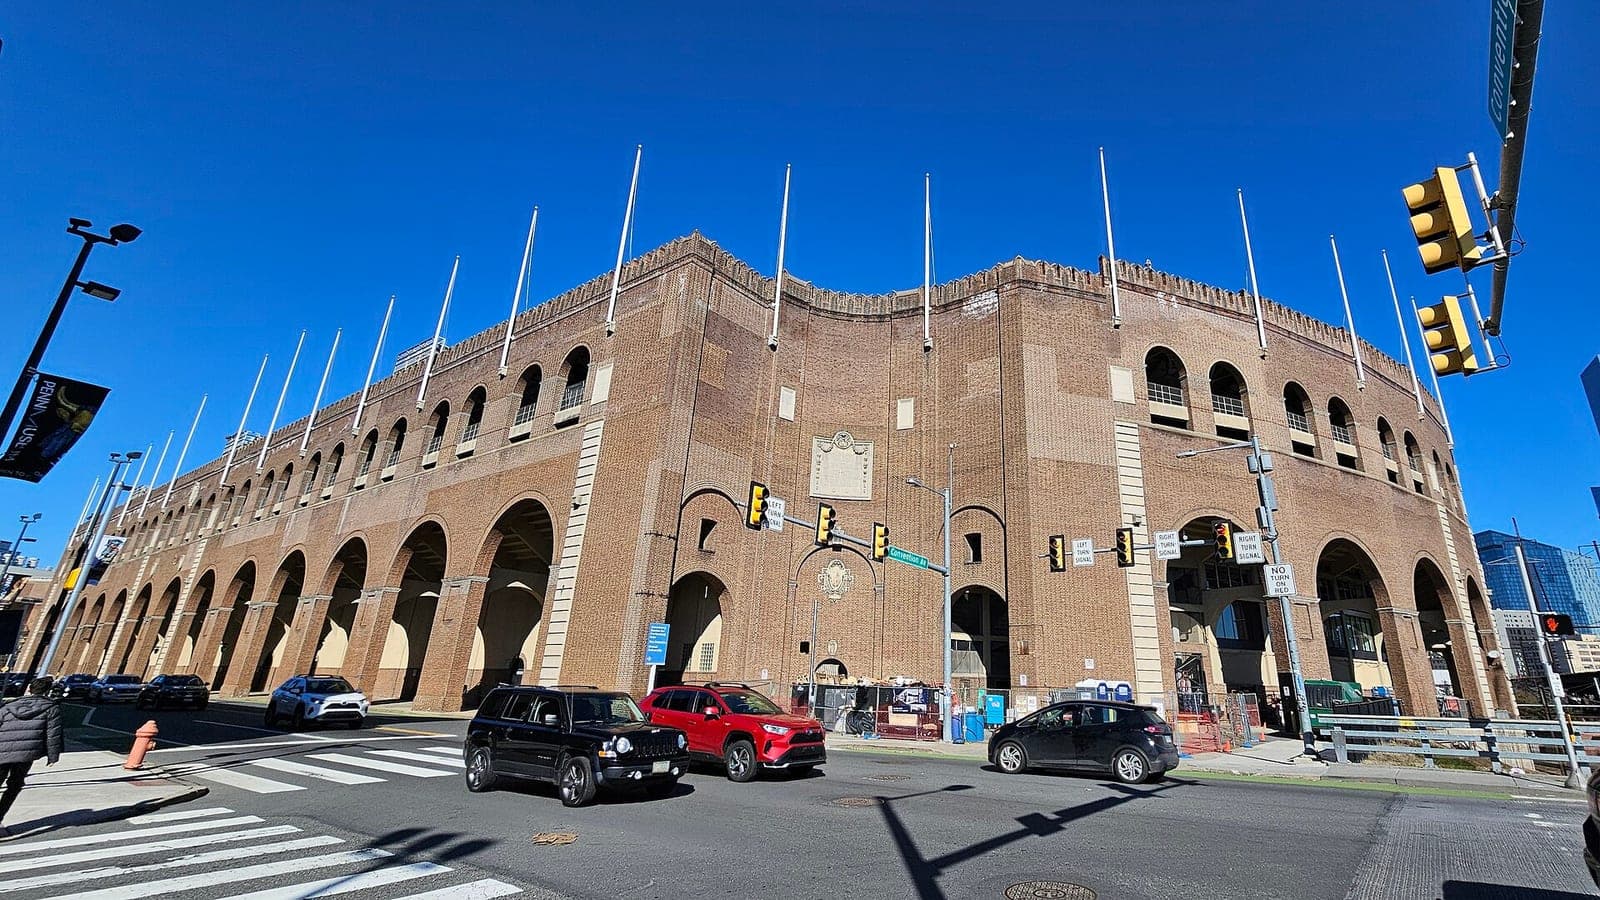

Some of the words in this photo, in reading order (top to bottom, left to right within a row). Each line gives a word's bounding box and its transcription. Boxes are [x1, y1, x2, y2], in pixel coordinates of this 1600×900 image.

[33, 380, 56, 409] PENN
[768, 500, 782, 509] LEFT
[1240, 543, 1257, 551] TURN
[890, 548, 920, 564] Convention
[1075, 556, 1092, 564] SIGNAL
[1239, 552, 1261, 560] SIGNAL
[1271, 566, 1286, 575] NO
